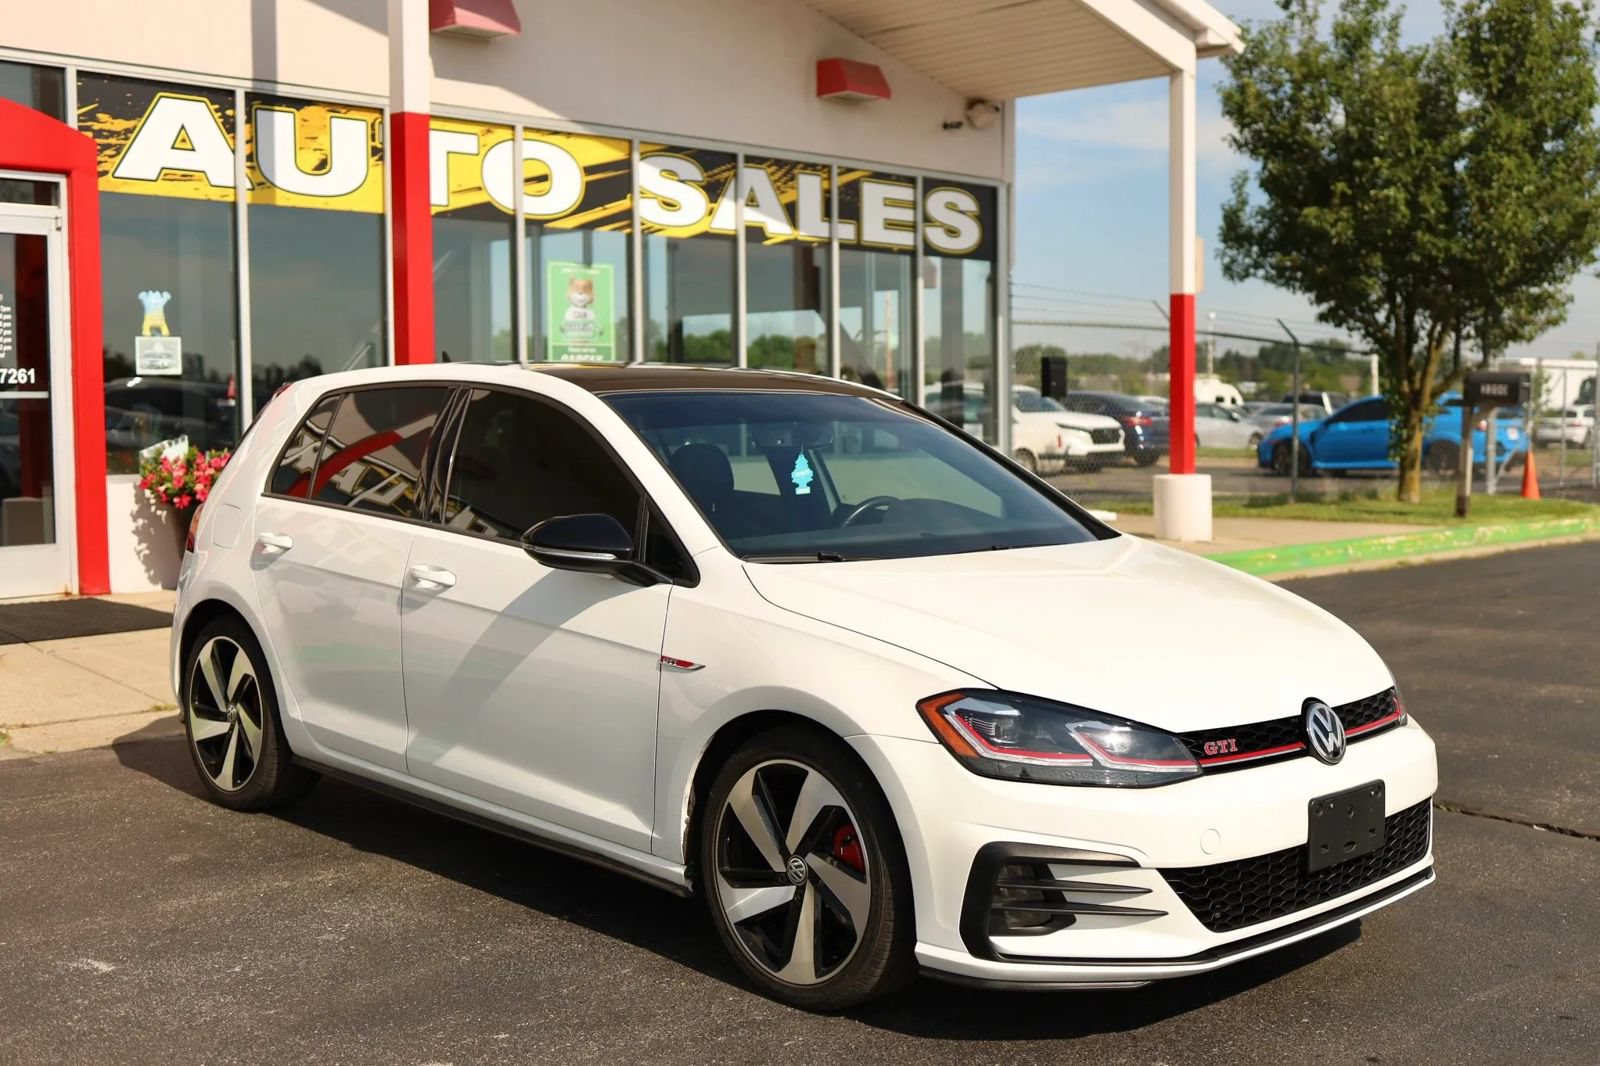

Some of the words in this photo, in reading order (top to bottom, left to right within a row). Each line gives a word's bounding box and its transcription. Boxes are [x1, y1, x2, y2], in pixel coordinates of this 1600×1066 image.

[110, 93, 584, 217] AUTO
[637, 152, 982, 254] SALES
[1204, 738, 1238, 756] GTI
